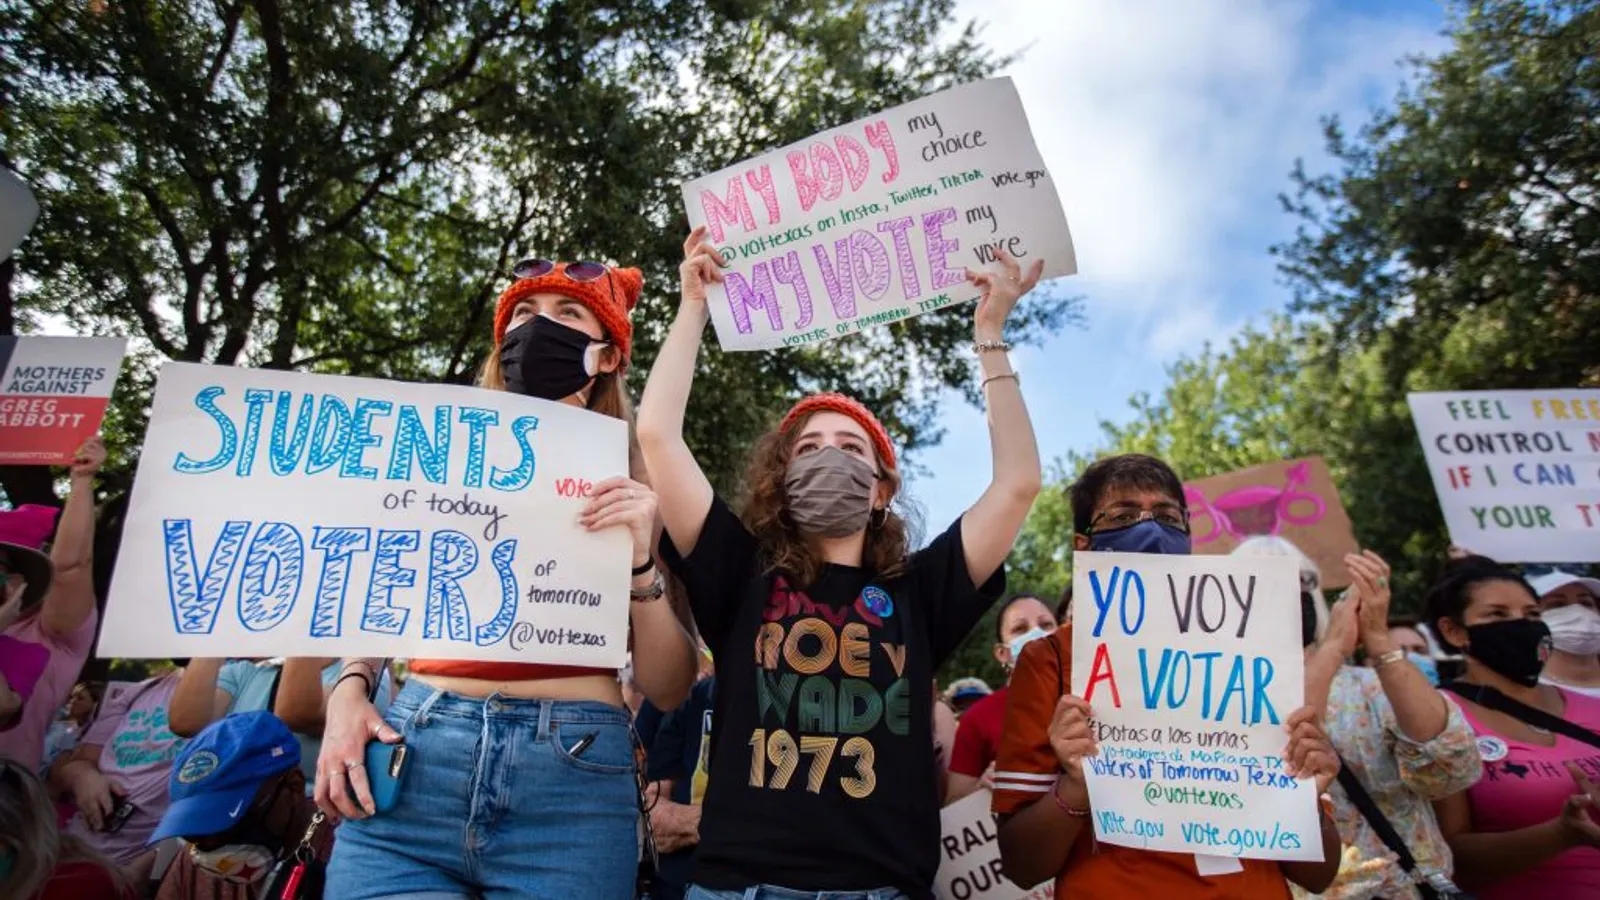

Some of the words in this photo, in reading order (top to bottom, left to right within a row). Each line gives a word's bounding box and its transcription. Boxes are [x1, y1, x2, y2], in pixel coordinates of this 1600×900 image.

[907, 112, 943, 138] my
[922, 130, 987, 162] choice
[700, 164, 780, 245] MY
[786, 120, 900, 212] BODY
[991, 169, 1045, 189] vote.gov
[817, 216, 836, 232] on
[965, 204, 997, 233] my
[724, 250, 813, 335] MY
[813, 207, 967, 320] VOTE
[782, 327, 830, 346] VOTERS
[836, 322, 851, 334] OF
[7, 380, 92, 394] AGAINST
[12, 366, 106, 381] MOTHERS
[0, 398, 58, 413] GREG
[1446, 399, 1511, 421] FEEL
[173, 385, 539, 491] STUDENTS
[1435, 431, 1572, 455] CONTROL
[1447, 465, 1473, 491] IF
[1485, 464, 1498, 487] I
[1513, 462, 1577, 486] CAN
[384, 490, 418, 509] of
[426, 492, 508, 541] today
[1471, 504, 1556, 530] YOUR
[163, 518, 518, 647] VOTERS
[534, 560, 557, 576] of
[526, 585, 601, 607] tomorrow
[1088, 566, 1146, 637] YO
[1167, 573, 1256, 638] VOY
[509, 621, 606, 651] @vottexas
[754, 617, 870, 677] ROE
[1082, 642, 1121, 708] A
[1137, 648, 1280, 725] VOTAR
[756, 667, 910, 736] WADE
[1151, 728, 1162, 744] a
[1168, 726, 1192, 744] las
[749, 728, 876, 798] 1973
[1088, 755, 1136, 778] Voters
[1139, 758, 1154, 780] of
[1157, 761, 1239, 782] Tomorrow
[1242, 764, 1298, 789] Texas
[1264, 755, 1283, 769] TX
[1144, 781, 1245, 809] @vottexas
[1097, 809, 1164, 847] vote.gov
[1181, 821, 1301, 856] vote.gov/es
